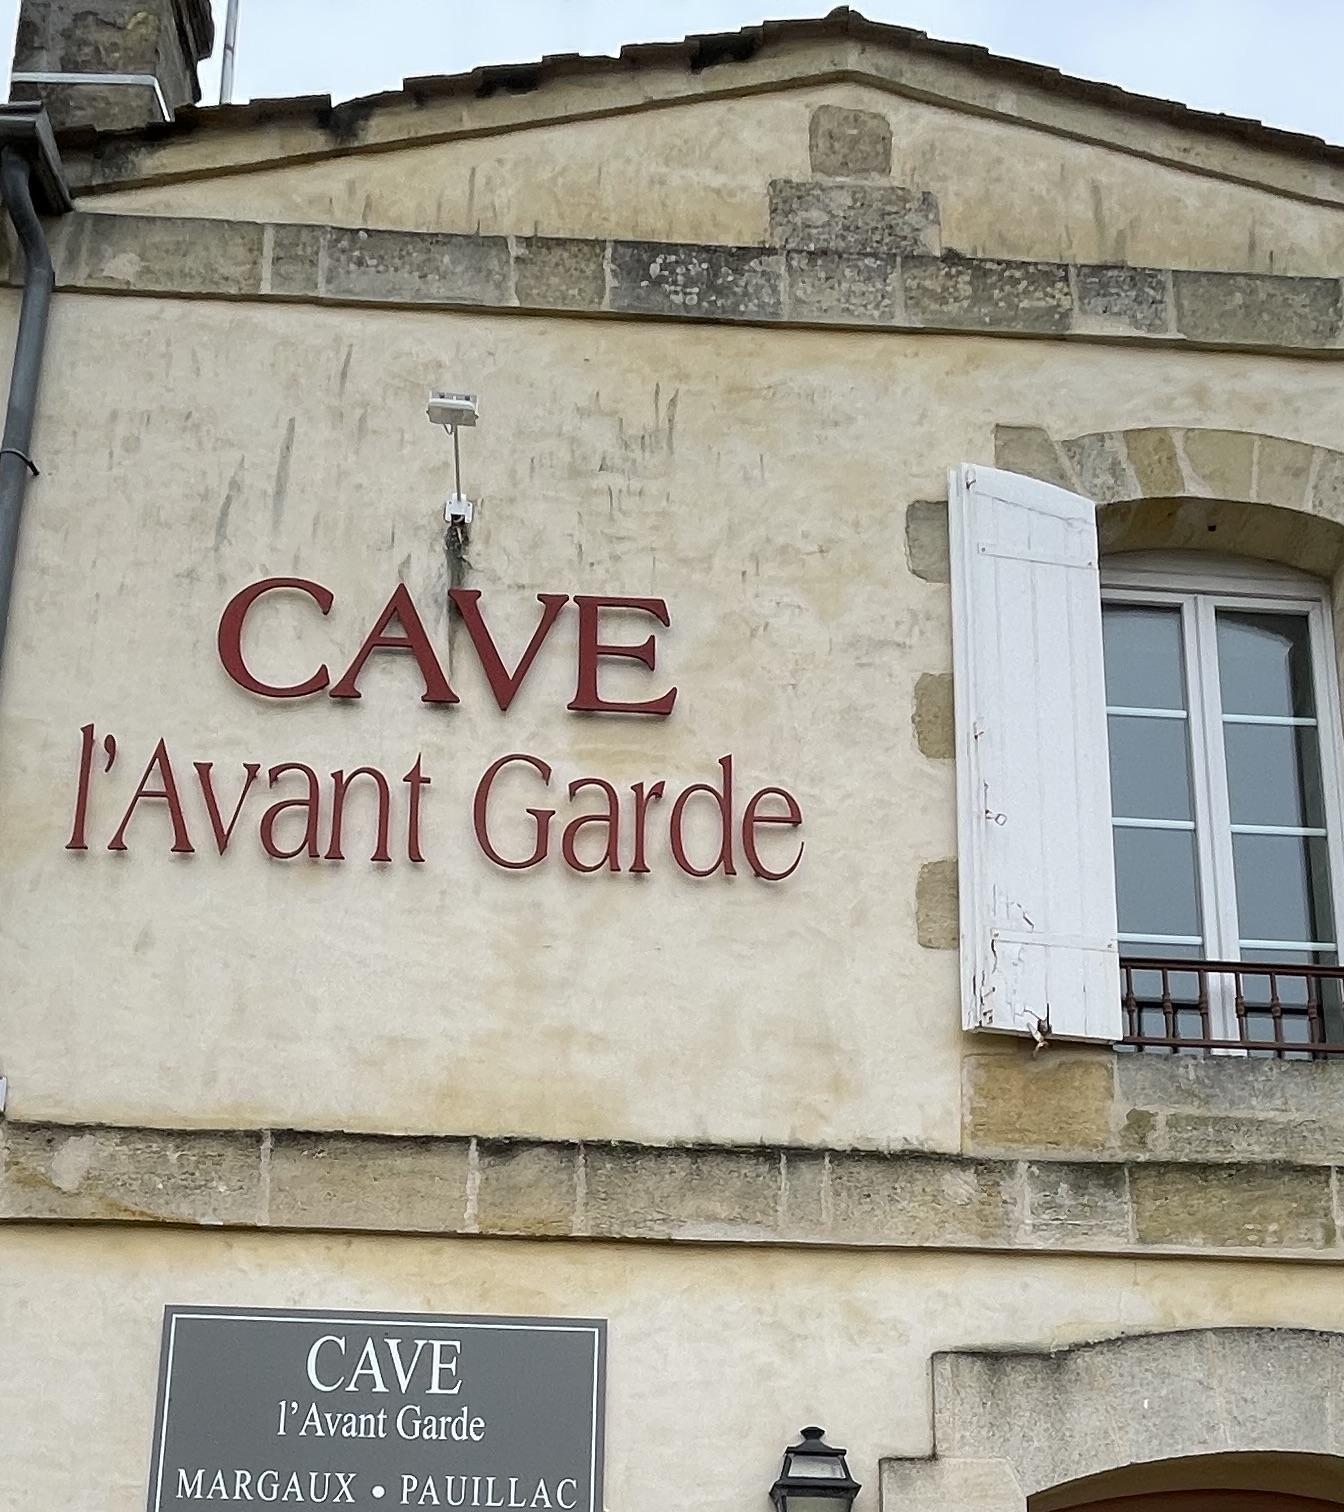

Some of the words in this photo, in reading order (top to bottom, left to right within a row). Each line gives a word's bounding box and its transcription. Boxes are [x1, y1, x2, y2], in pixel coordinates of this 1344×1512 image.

[217, 577, 677, 715] CAVE
[65, 723, 432, 863] l'Avant
[474, 754, 804, 881] Garde
[308, 1336, 462, 1394] CAVE
[278, 1401, 387, 1437] l'Avant
[397, 1405, 484, 1440] Garde
[176, 1469, 356, 1502] MARGAUX
[401, 1475, 576, 1508] PAUILLAC
